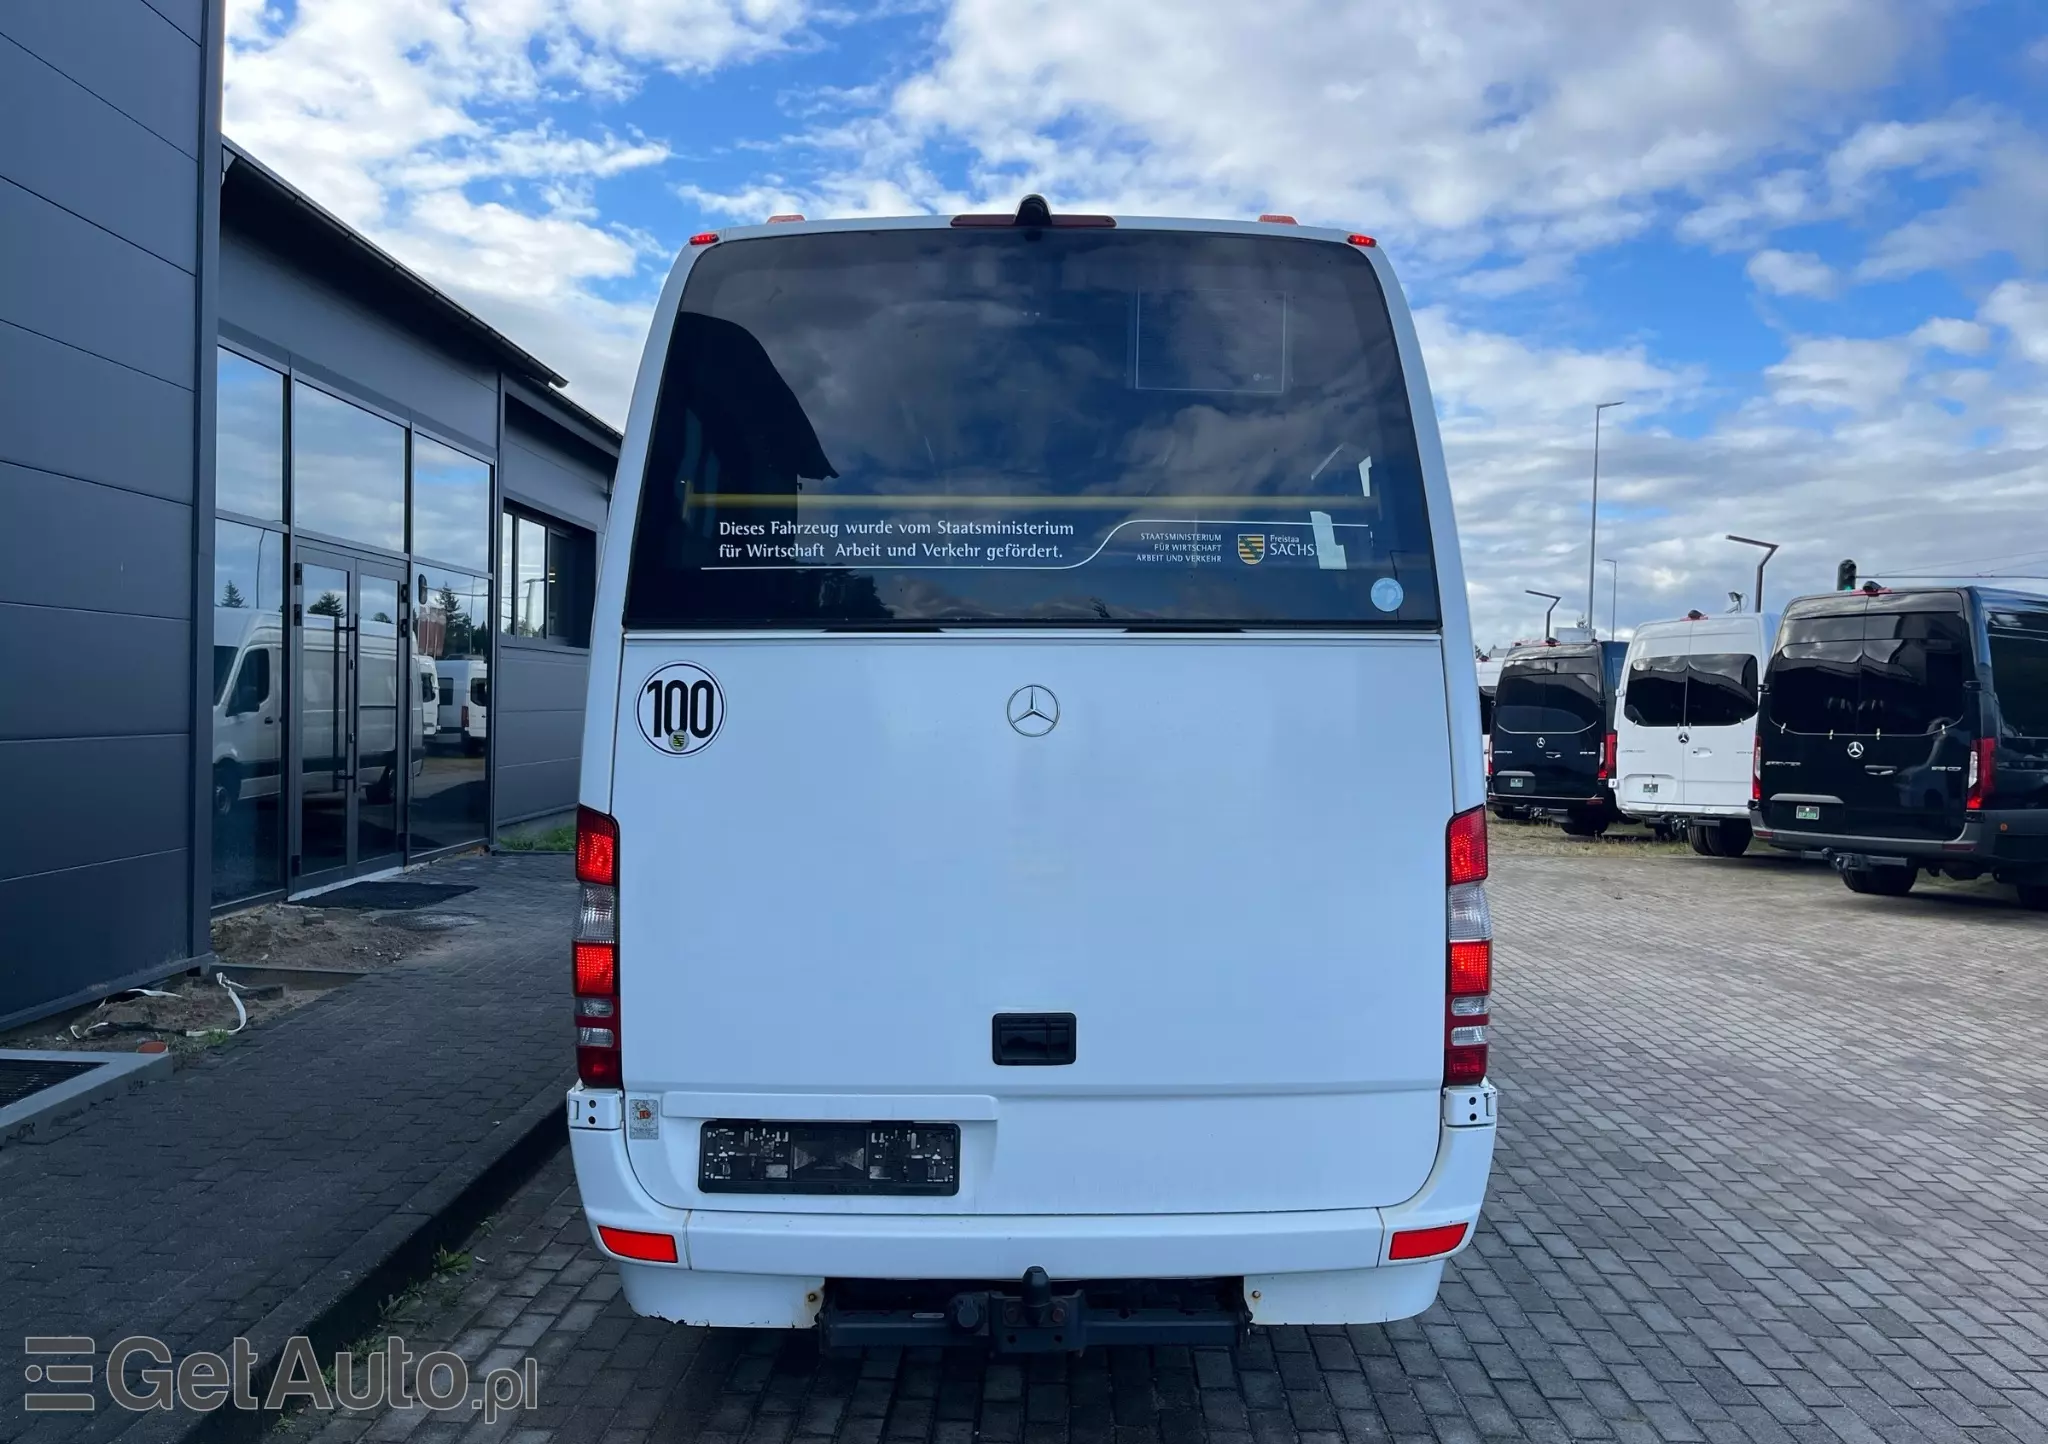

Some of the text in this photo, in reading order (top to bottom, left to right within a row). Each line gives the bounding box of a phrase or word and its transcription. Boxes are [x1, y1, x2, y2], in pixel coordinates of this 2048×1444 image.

[719, 520, 1075, 538] Dieses Fahrzeug wurde vom Staatsministerium
[1140, 532, 1222, 541] STAATSMINISTERIUM
[719, 542, 1064, 560] für Wirtschaft Arbeit und Verkehr gefördert.
[1154, 542, 1222, 552] FÜR WIRTSCHAFT
[1269, 543, 1319, 556] SACHS
[1136, 553, 1222, 563] ARBEIT UND VERKEHR
[646, 679, 714, 739] 100
